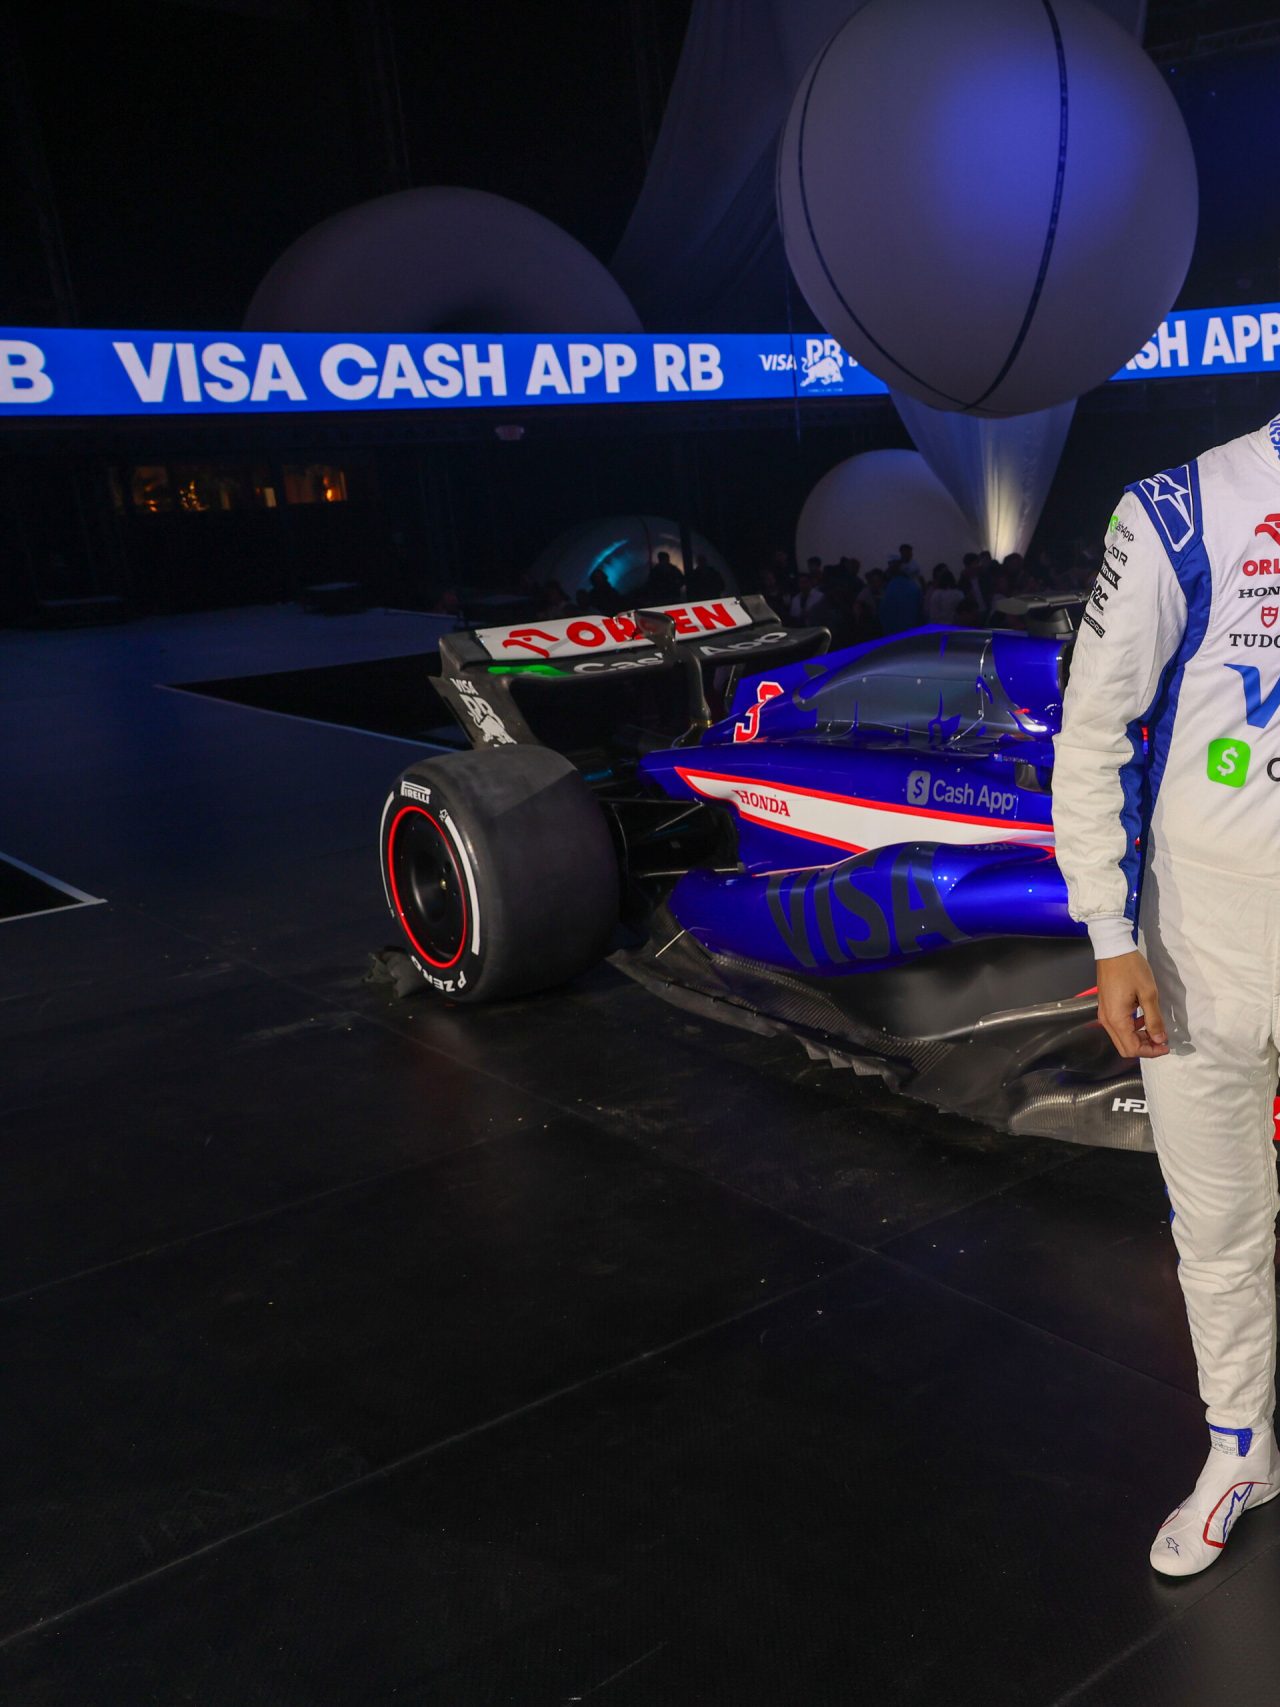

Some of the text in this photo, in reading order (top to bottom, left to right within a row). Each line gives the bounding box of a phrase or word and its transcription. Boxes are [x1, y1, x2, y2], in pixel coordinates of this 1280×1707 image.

[112, 342, 724, 403] VISA CASH APP RB
[759, 354, 797, 371] VISA
[566, 603, 737, 647] OREN
[573, 652, 664, 675] Cas
[450, 678, 479, 695] VISA
[401, 781, 431, 804] PIRELLI
[732, 790, 791, 818] HONDA
[932, 779, 974, 806] Cash
[977, 784, 1014, 814] App
[766, 841, 972, 967] VISA
[457, 971, 467, 989] P
